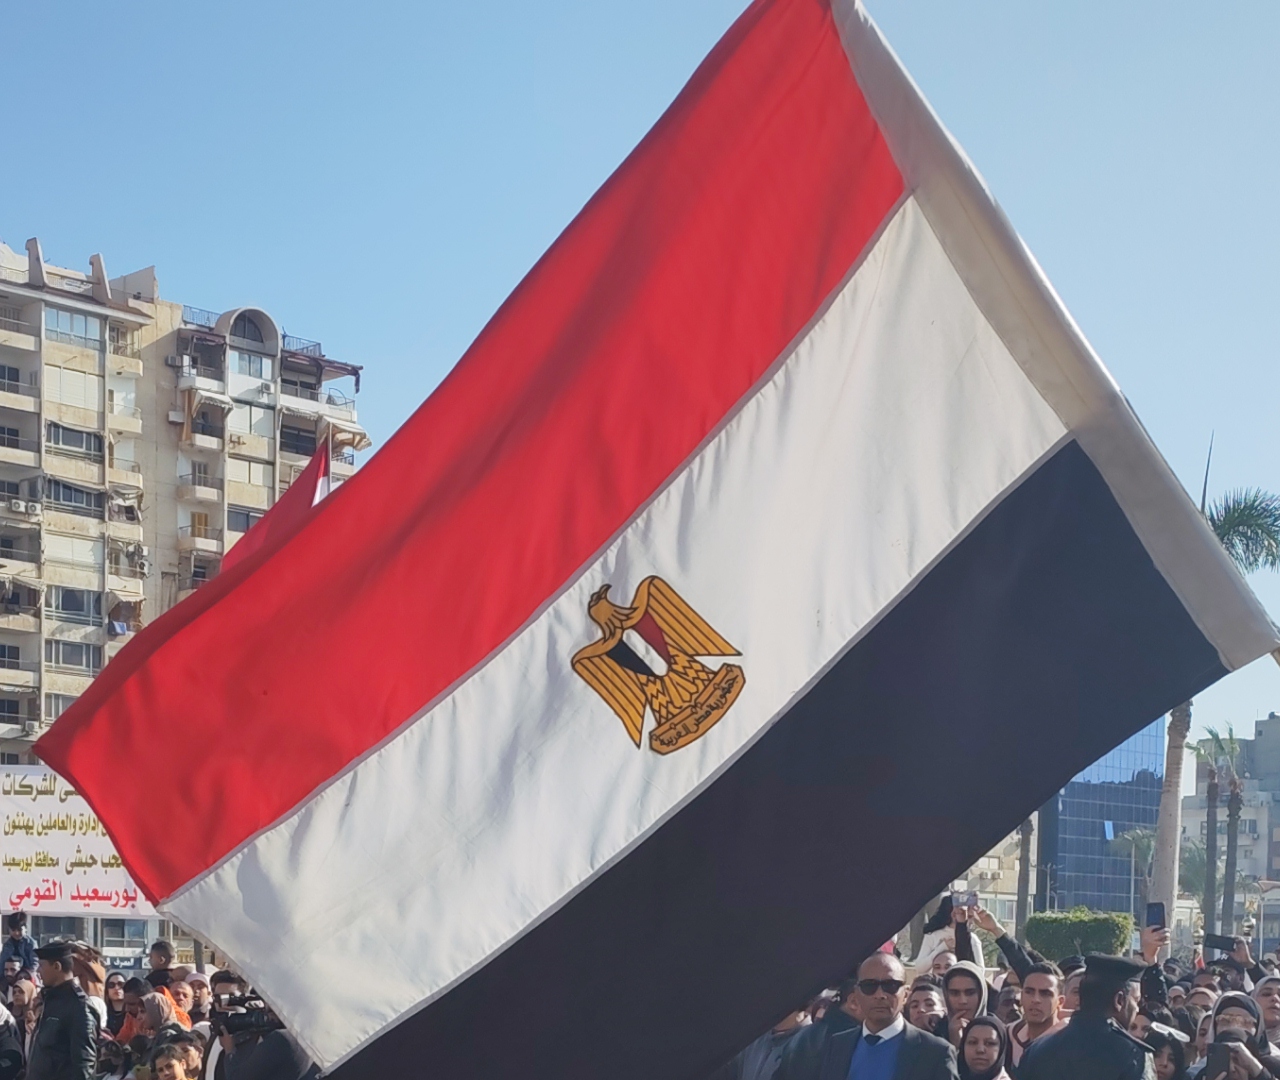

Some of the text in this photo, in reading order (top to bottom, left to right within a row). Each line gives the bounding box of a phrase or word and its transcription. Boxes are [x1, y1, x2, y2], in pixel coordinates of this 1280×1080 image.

[659, 674, 739, 747] جمهورية مصر العربية
[2, 773, 58, 803] للشركات
[3, 811, 35, 837] يهنئون
[37, 811, 77, 837] والعاملين
[2, 853, 33, 873] بورسعيد
[9, 878, 138, 911] بورسعيد القومي
